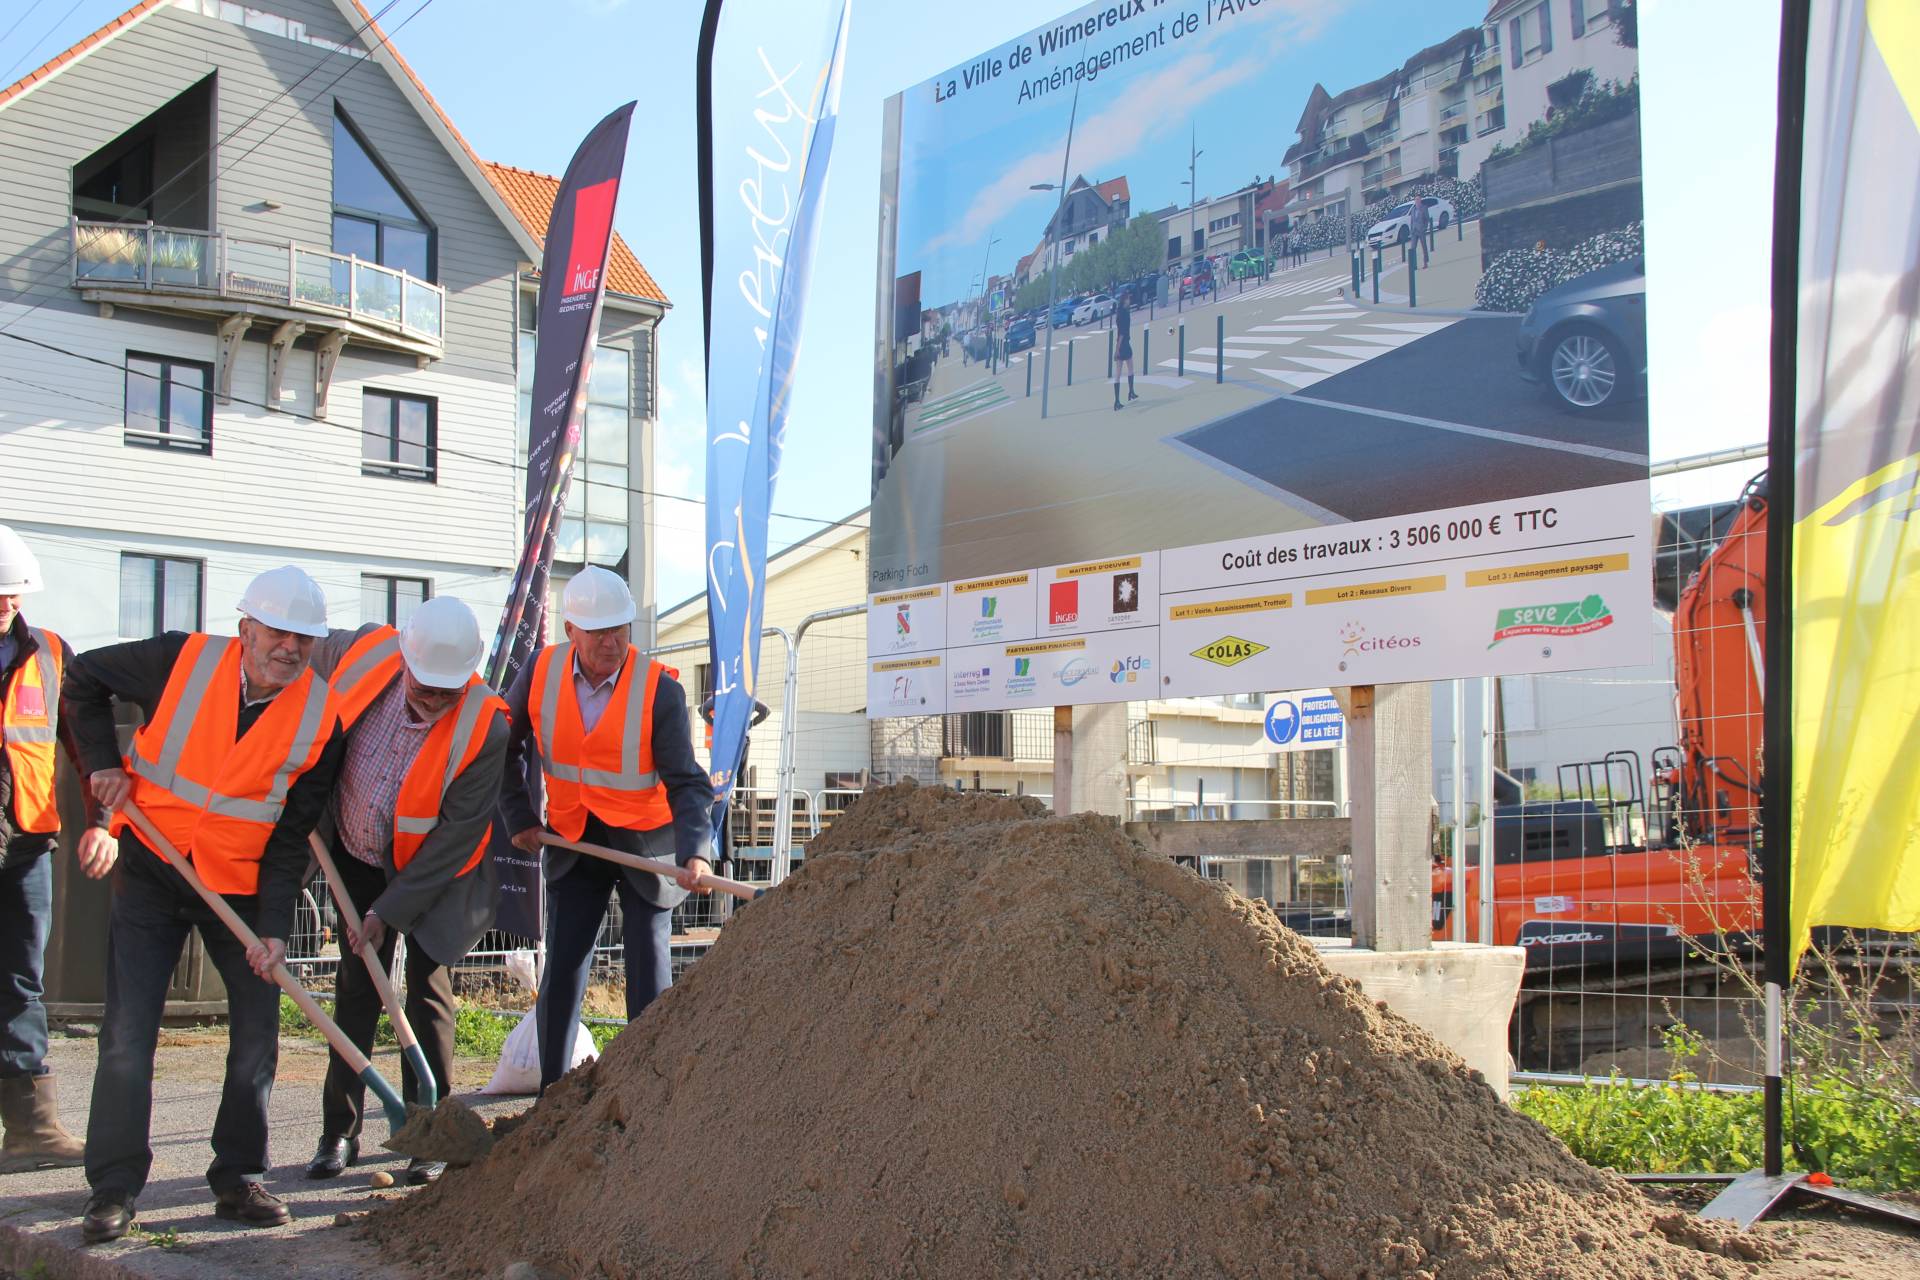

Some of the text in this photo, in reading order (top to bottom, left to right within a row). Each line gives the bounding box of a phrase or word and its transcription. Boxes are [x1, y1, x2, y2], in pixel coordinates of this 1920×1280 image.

[936, 0, 1145, 103] La Ville de Wimereux
[1018, 21, 1164, 104] Aménagement
[1172, 12, 1199, 39] de
[1222, 549, 1261, 571] Coût
[1267, 547, 1297, 565] des
[1303, 538, 1371, 560] travaux
[1390, 530, 1400, 548] 3
[1407, 525, 1440, 546] 506
[1448, 519, 1482, 540] 000
[1489, 515, 1501, 535] €
[1514, 508, 1557, 532] TTC
[873, 562, 928, 582] Parking Foch
[1264, 599, 1287, 607] Trottoir
[1514, 606, 1557, 623] seve
[1207, 644, 1251, 658] COLAS
[1360, 635, 1421, 651] citéos
[1127, 656, 1151, 670] fde
[1302, 713, 1342, 725] OBLIGATOIRE
[1304, 725, 1339, 738] DE LA TÊTE
